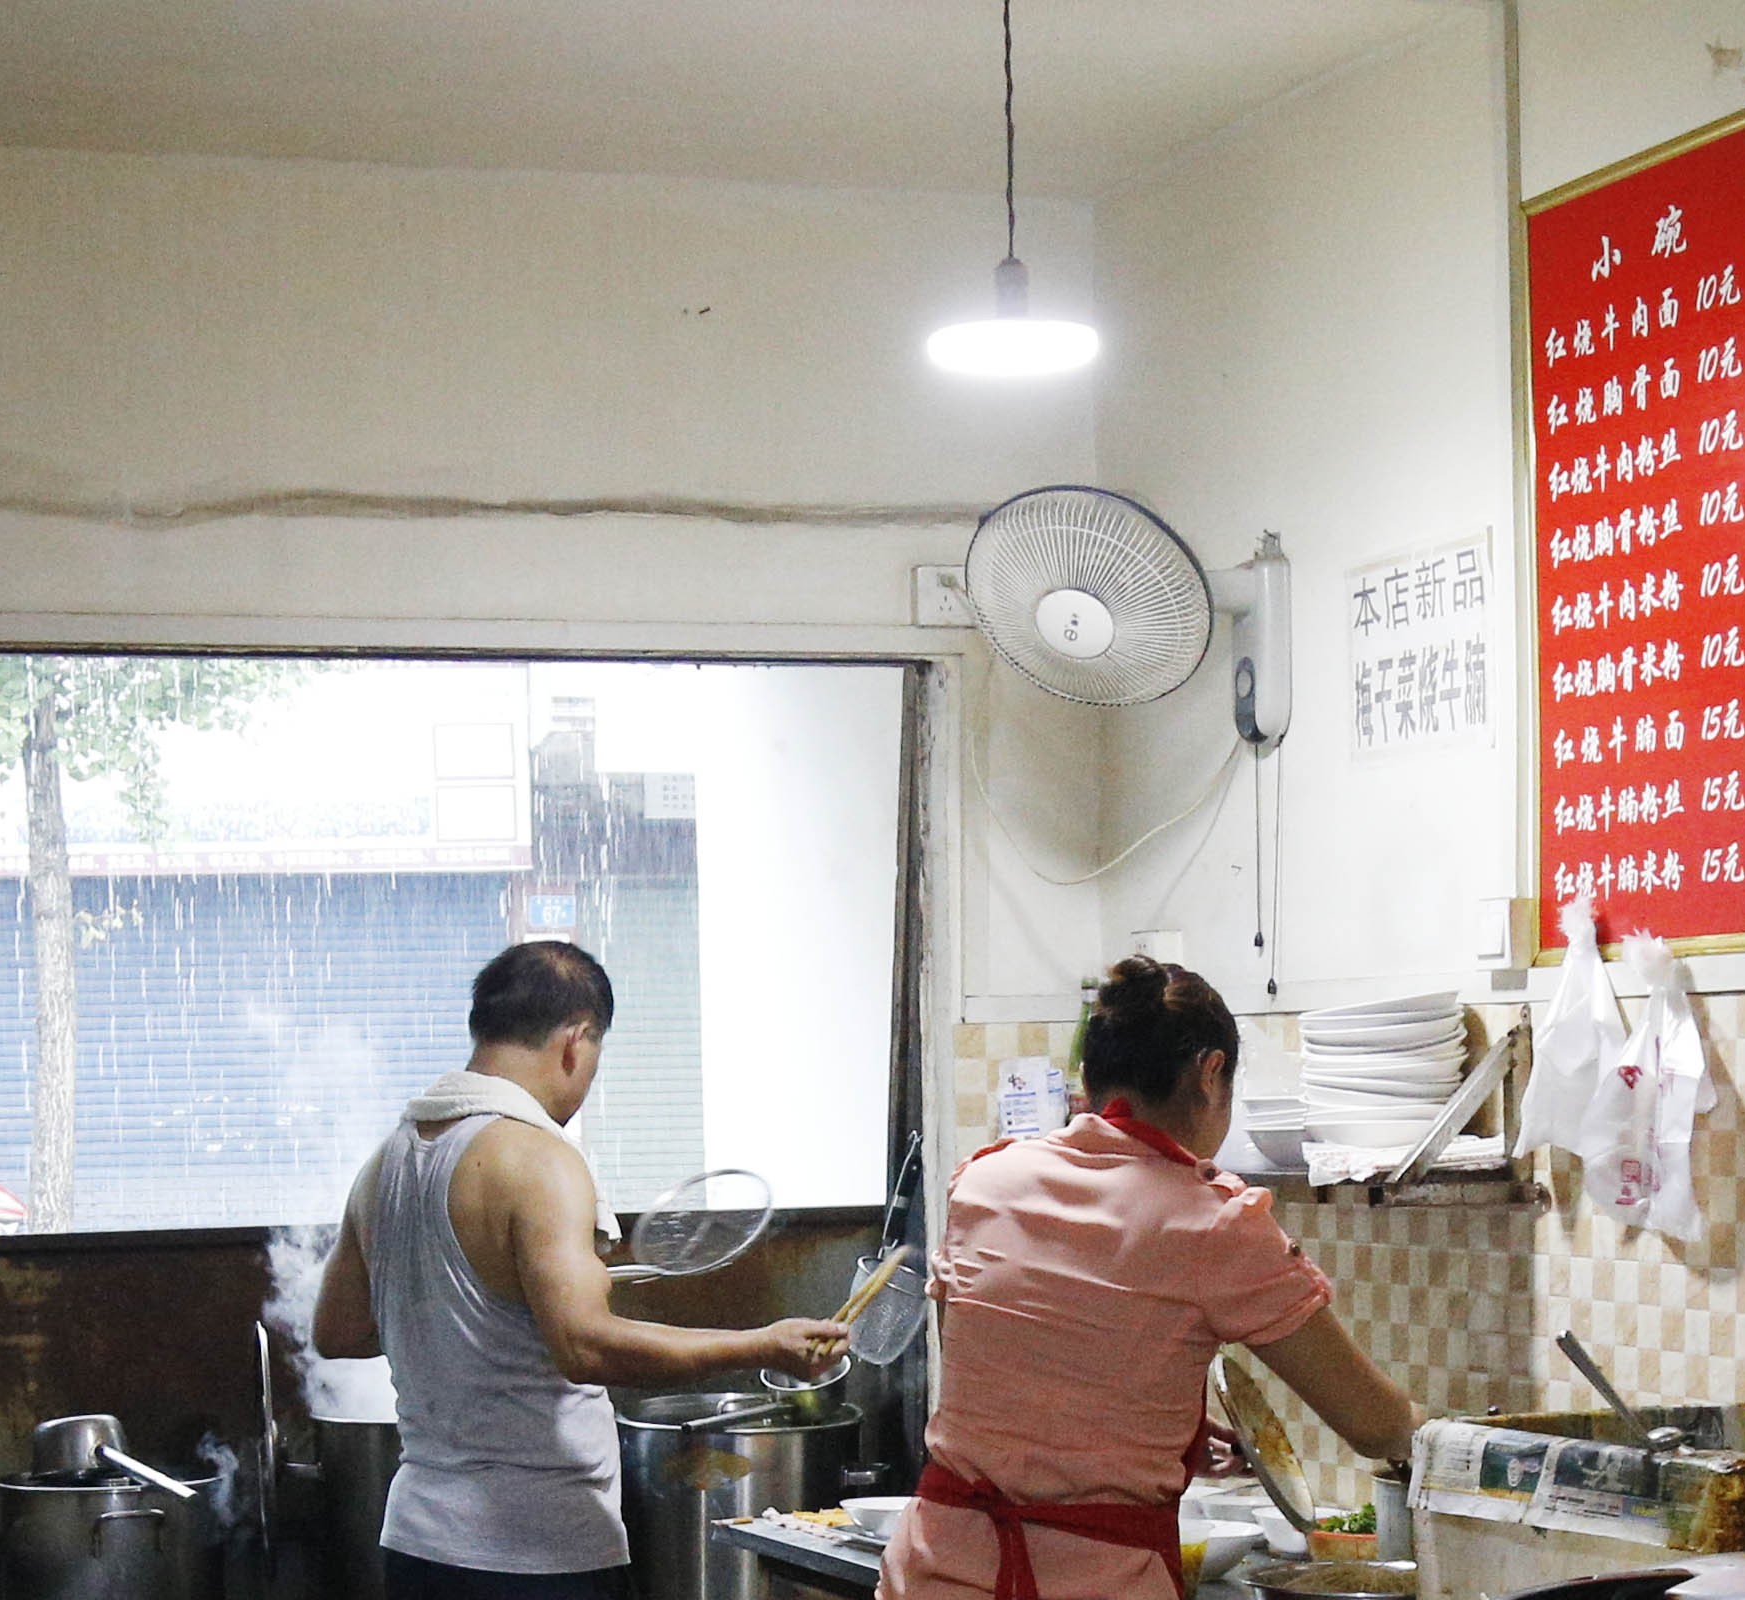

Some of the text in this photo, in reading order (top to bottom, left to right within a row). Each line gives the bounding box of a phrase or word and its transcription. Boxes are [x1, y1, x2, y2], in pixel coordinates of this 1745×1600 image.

[1591, 205, 1687, 281] 小碗
[1545, 264, 1741, 367] 红烧牛肉面 10元
[1547, 337, 1742, 435] 红烧胸骨面 10元
[1548, 409, 1743, 502] 红烧牛肉粉丝 10元
[1550, 482, 1744, 568] 红烧胸骨粉丝 10元
[1354, 549, 1485, 636] 本店新品
[1551, 554, 1745, 635] 红烧牛肉米粉 10元
[1356, 632, 1486, 748] 梅干菜烧牛腩
[1552, 626, 1745, 702] 红烧胸骨米粉 10元
[1553, 699, 1745, 769] 红烧牛腩面 15元
[1554, 770, 1745, 835] 红烧牛腩粉丝 15元
[1554, 842, 1745, 901] 红烧牛腩米粉 15元
